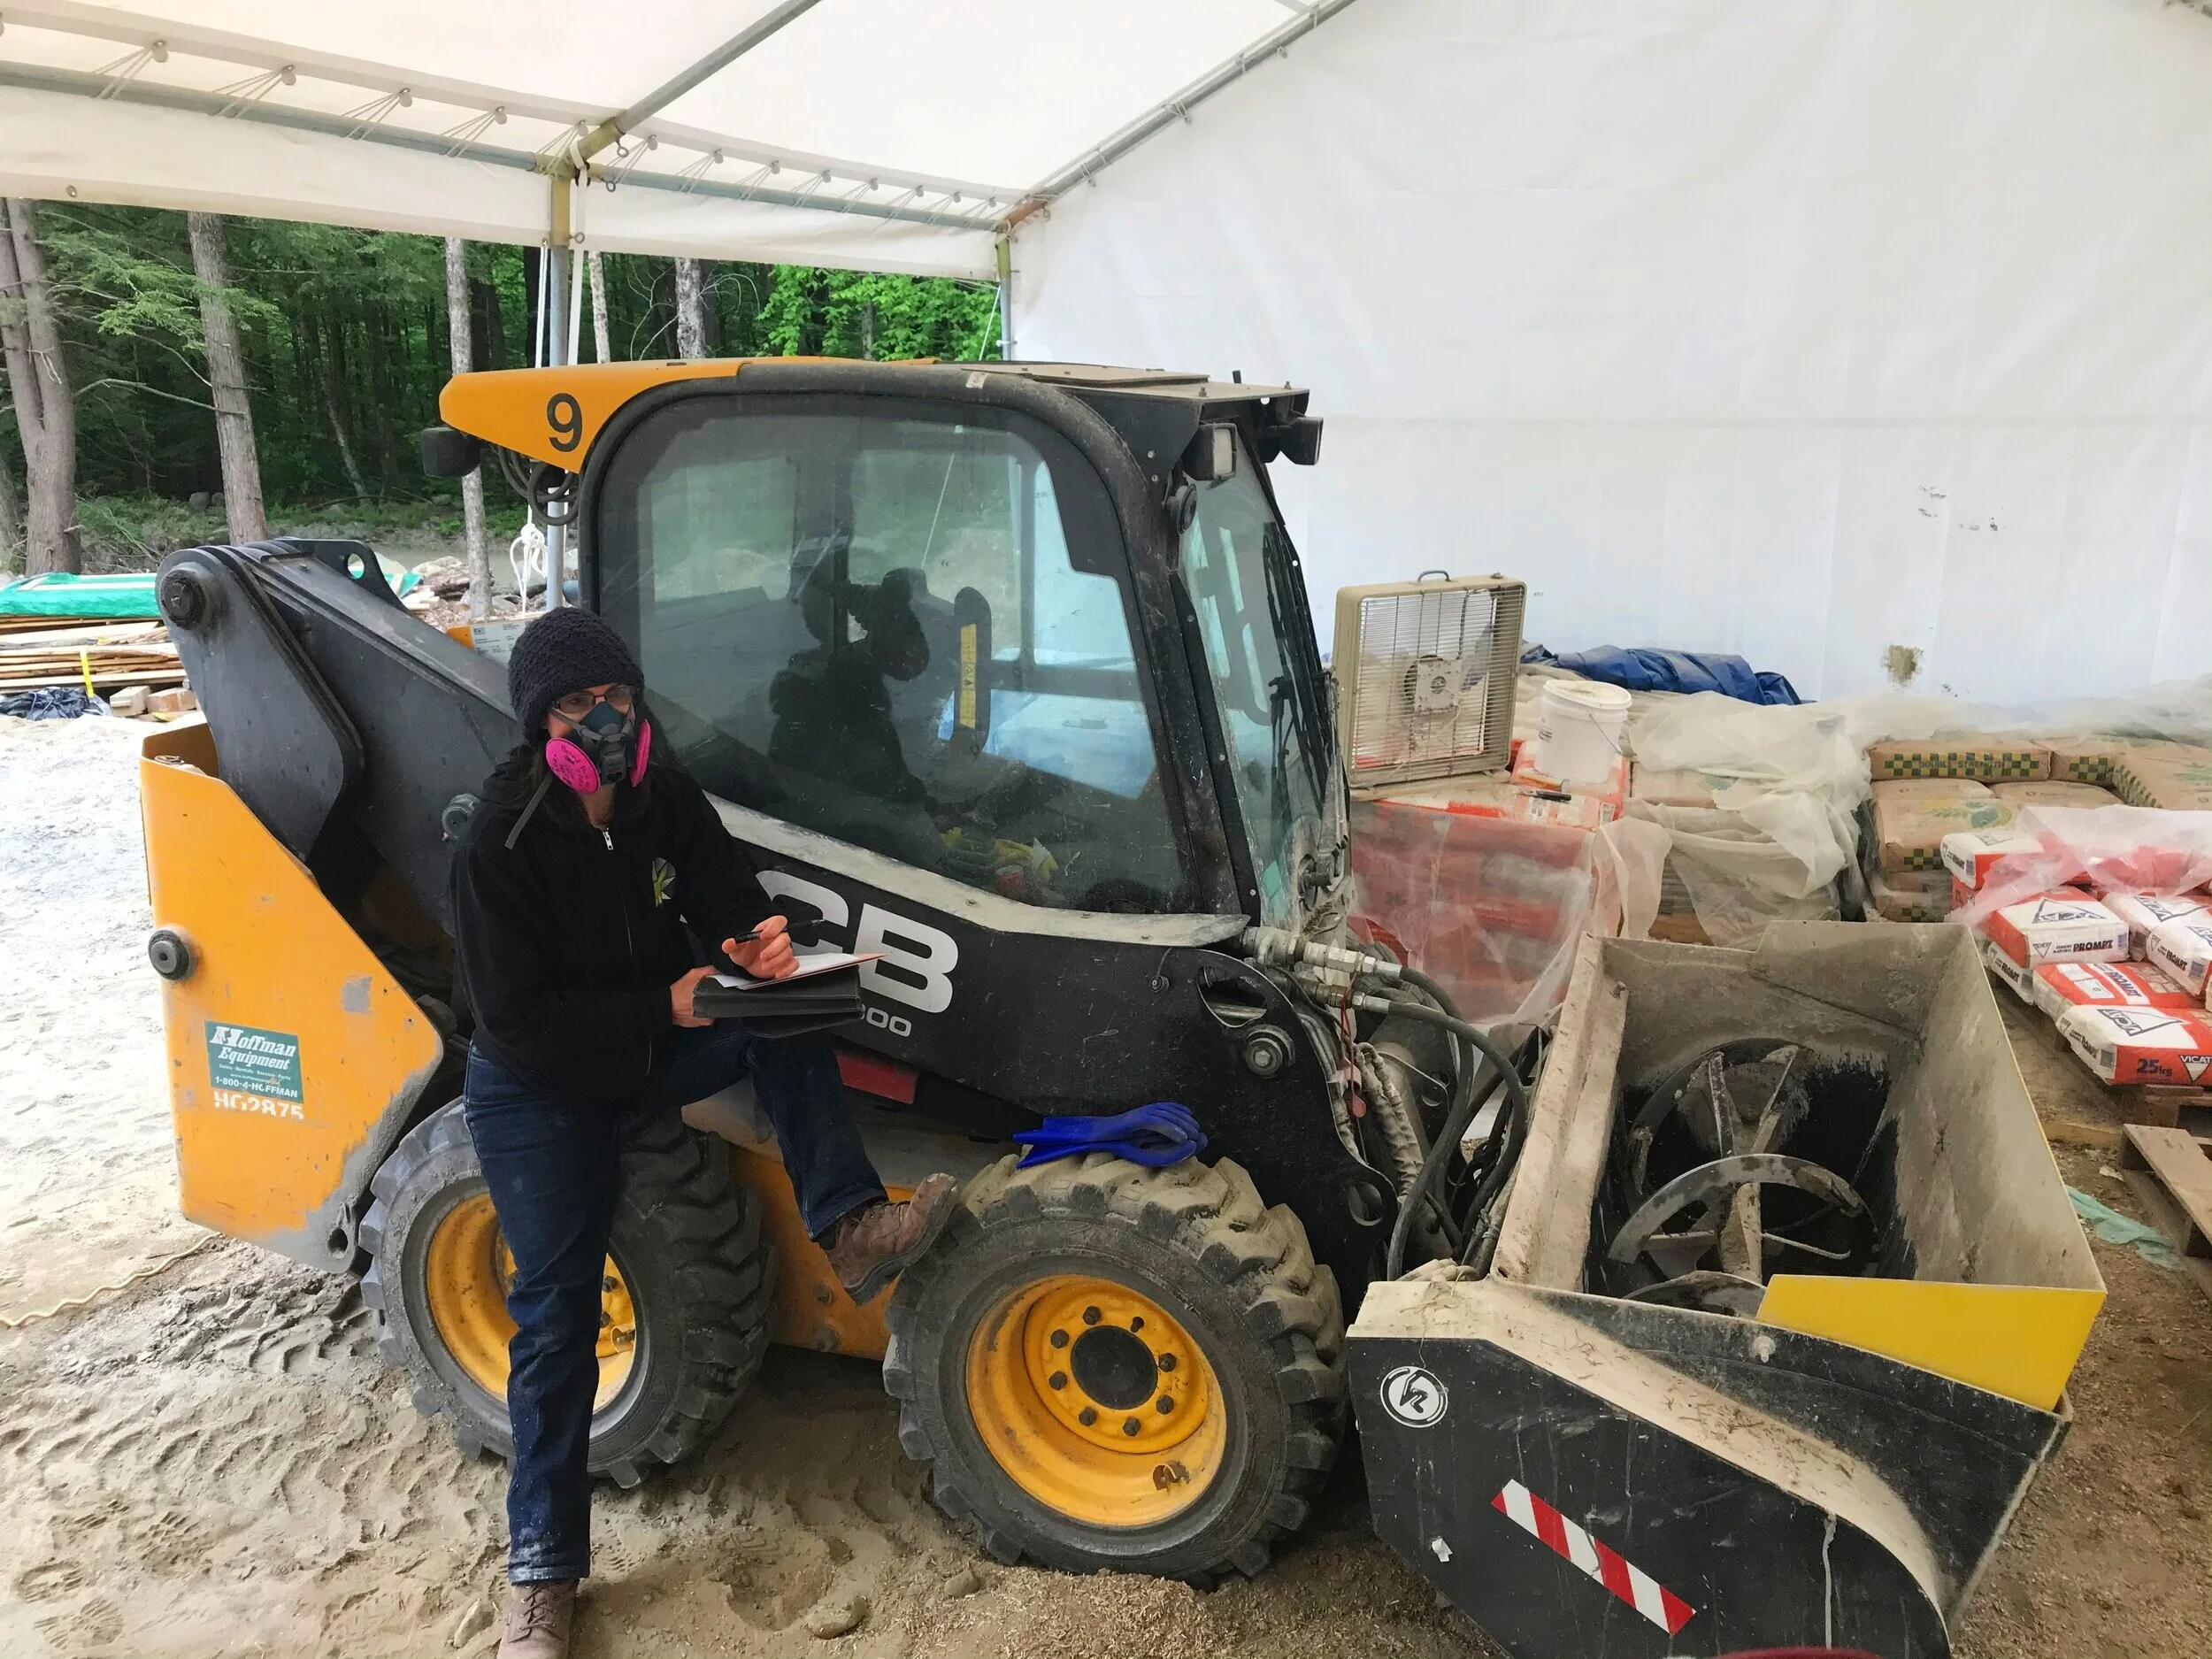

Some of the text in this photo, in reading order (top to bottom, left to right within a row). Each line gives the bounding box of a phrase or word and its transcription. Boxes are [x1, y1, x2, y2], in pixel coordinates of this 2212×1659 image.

[547, 393, 583, 452] 9
[755, 870, 959, 1013] CB
[2072, 940, 2114, 952] PROMPT
[861, 1003, 912, 1037] 00
[210, 1025, 296, 1057] Hoffman
[218, 1046, 291, 1070] Equipment
[2180, 1055, 2210, 1064] VICAT
